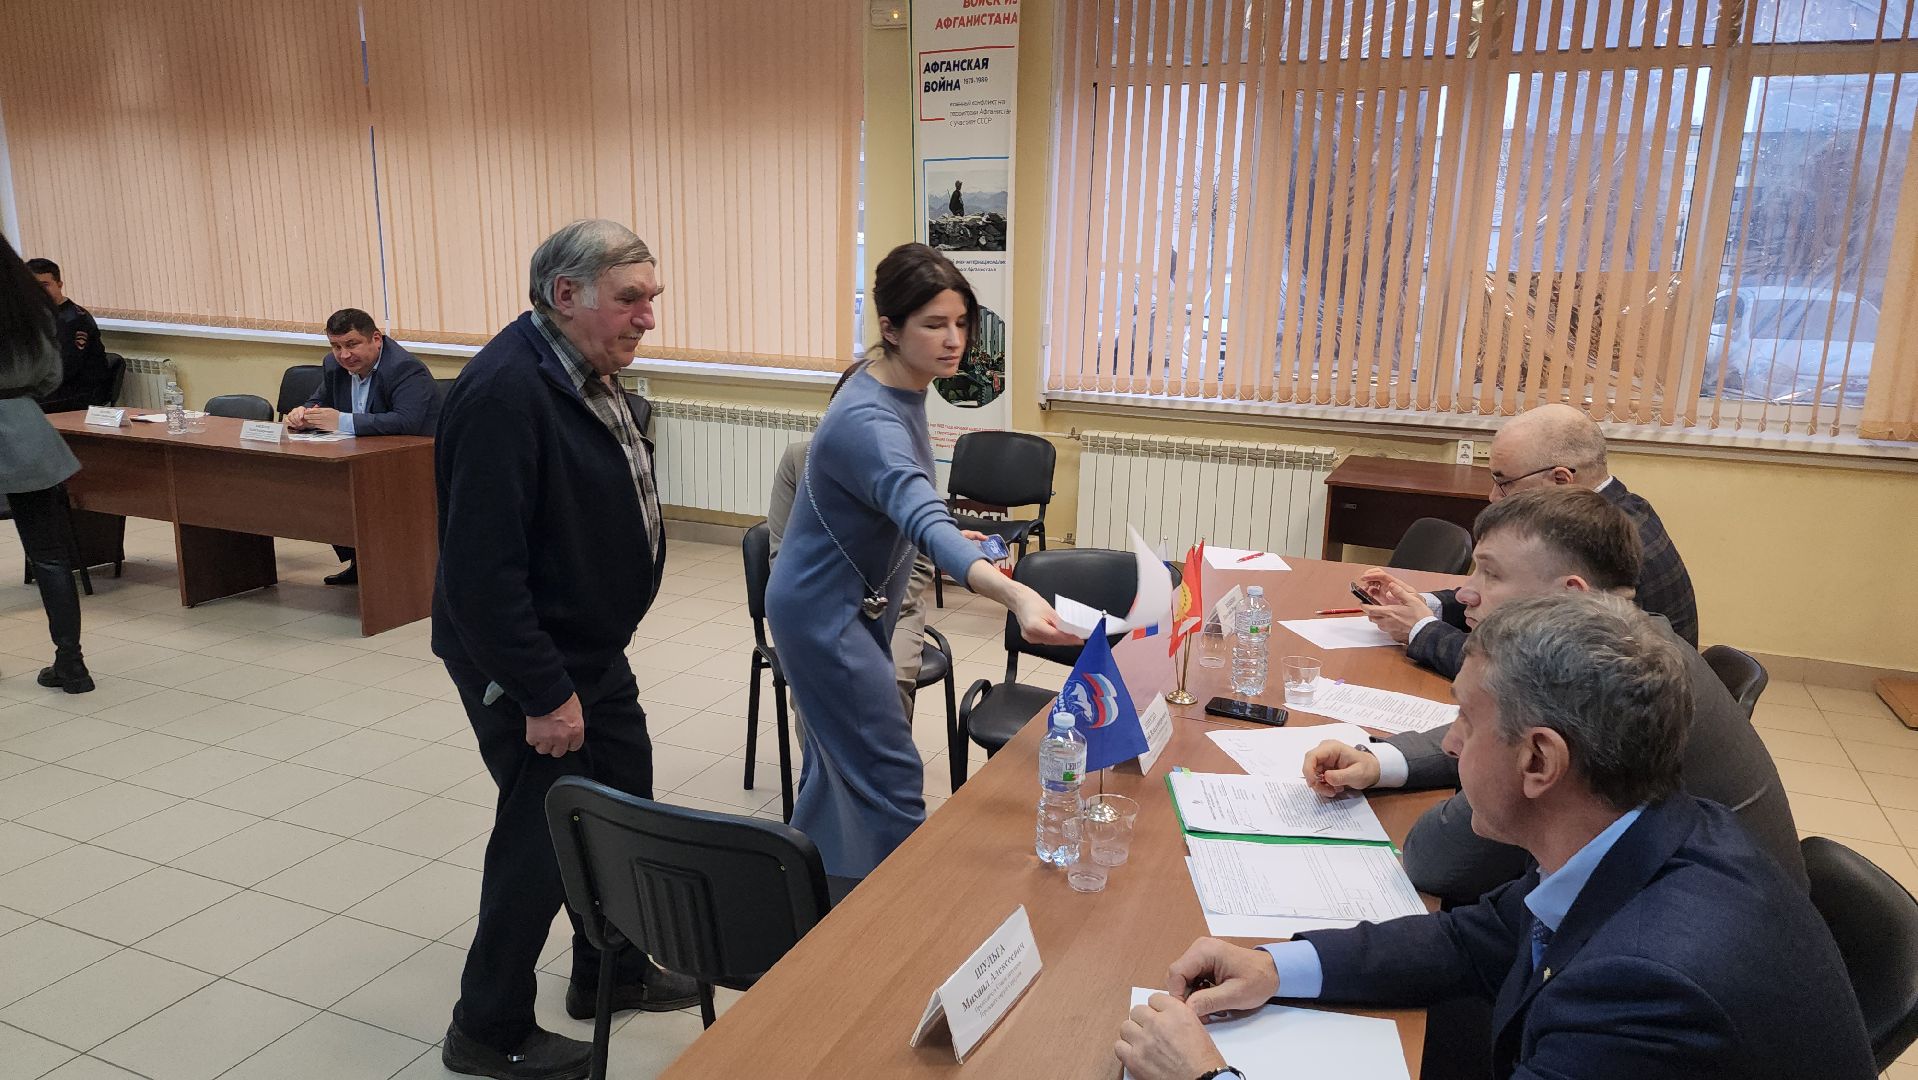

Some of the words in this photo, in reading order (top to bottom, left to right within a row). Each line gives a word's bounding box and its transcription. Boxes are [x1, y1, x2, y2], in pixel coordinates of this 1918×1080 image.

[935, 12, 1018, 30] АФГАНИСТАНА
[923, 58, 989, 74] АФГАНСКАЯ
[924, 77, 961, 93] ВОЙНА
[976, 117, 993, 125] СССР
[974, 944, 1006, 980] ШУЛЬГА
[961, 980, 990, 1013] Михаил
[990, 942, 1025, 984] Алексеевич
